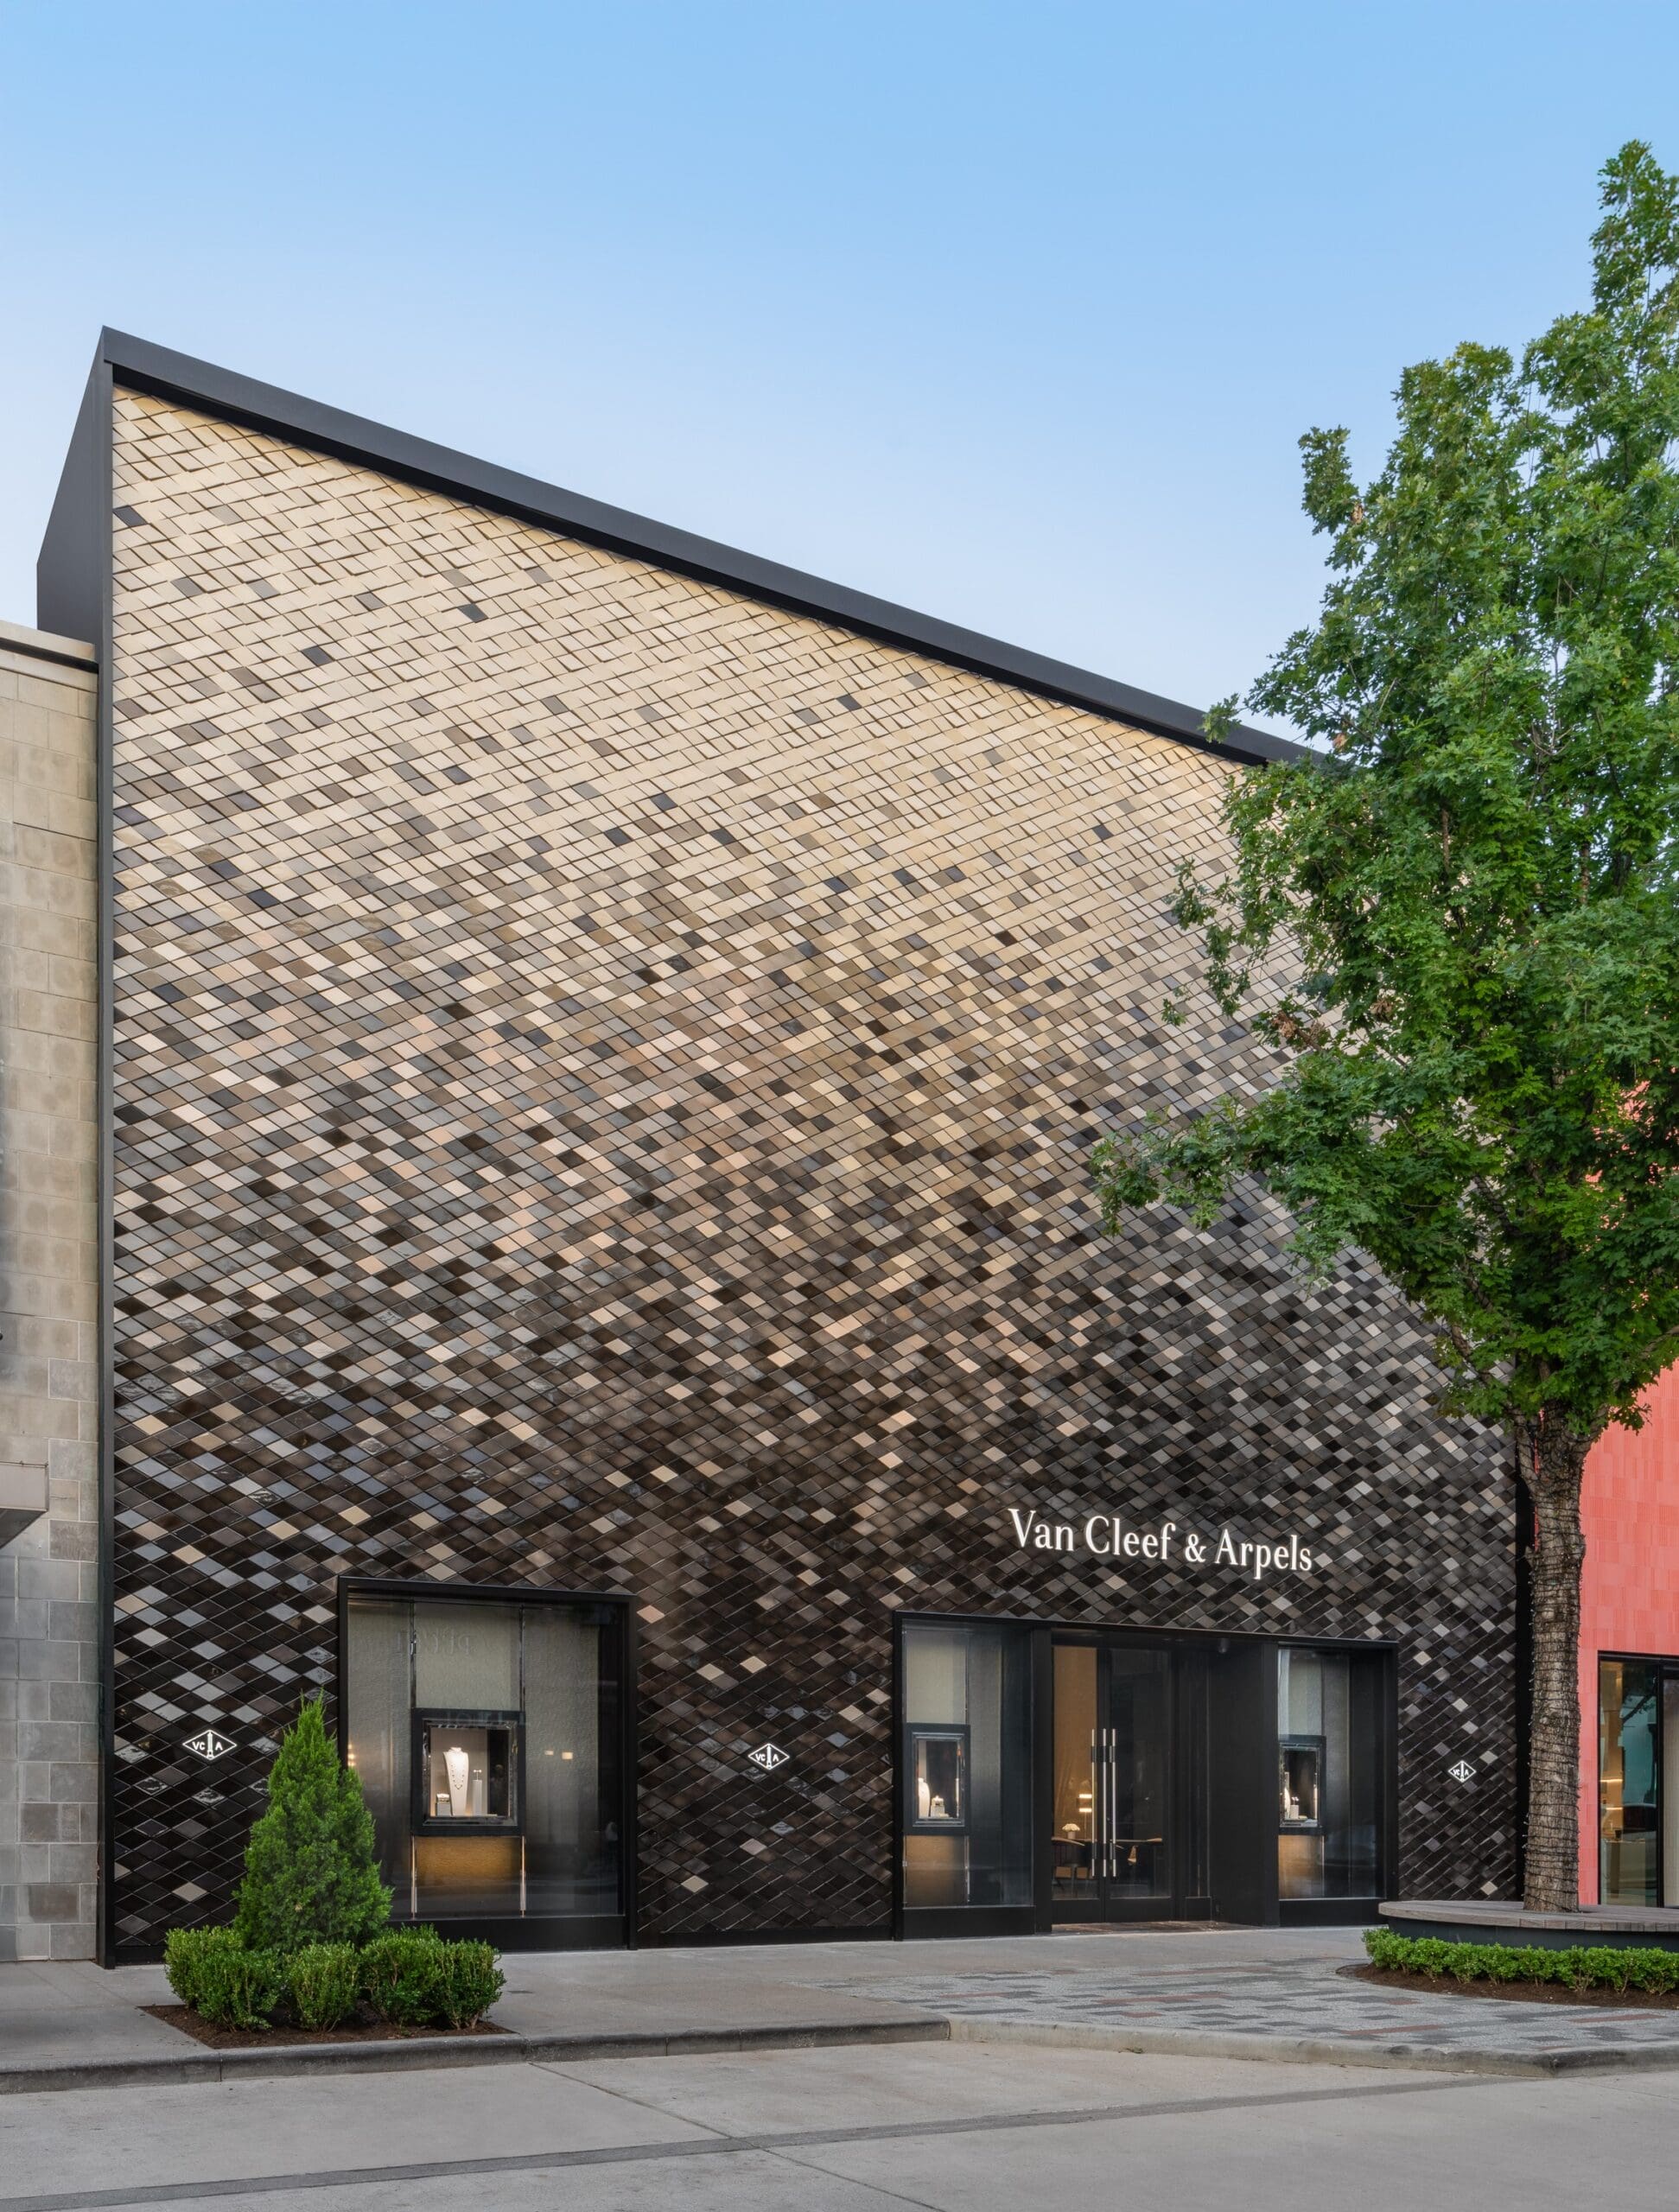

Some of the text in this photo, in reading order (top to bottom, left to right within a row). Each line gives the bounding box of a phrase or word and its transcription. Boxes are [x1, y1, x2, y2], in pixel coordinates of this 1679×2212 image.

[1008, 1508, 1313, 1580] Van Cleef & Arpels
